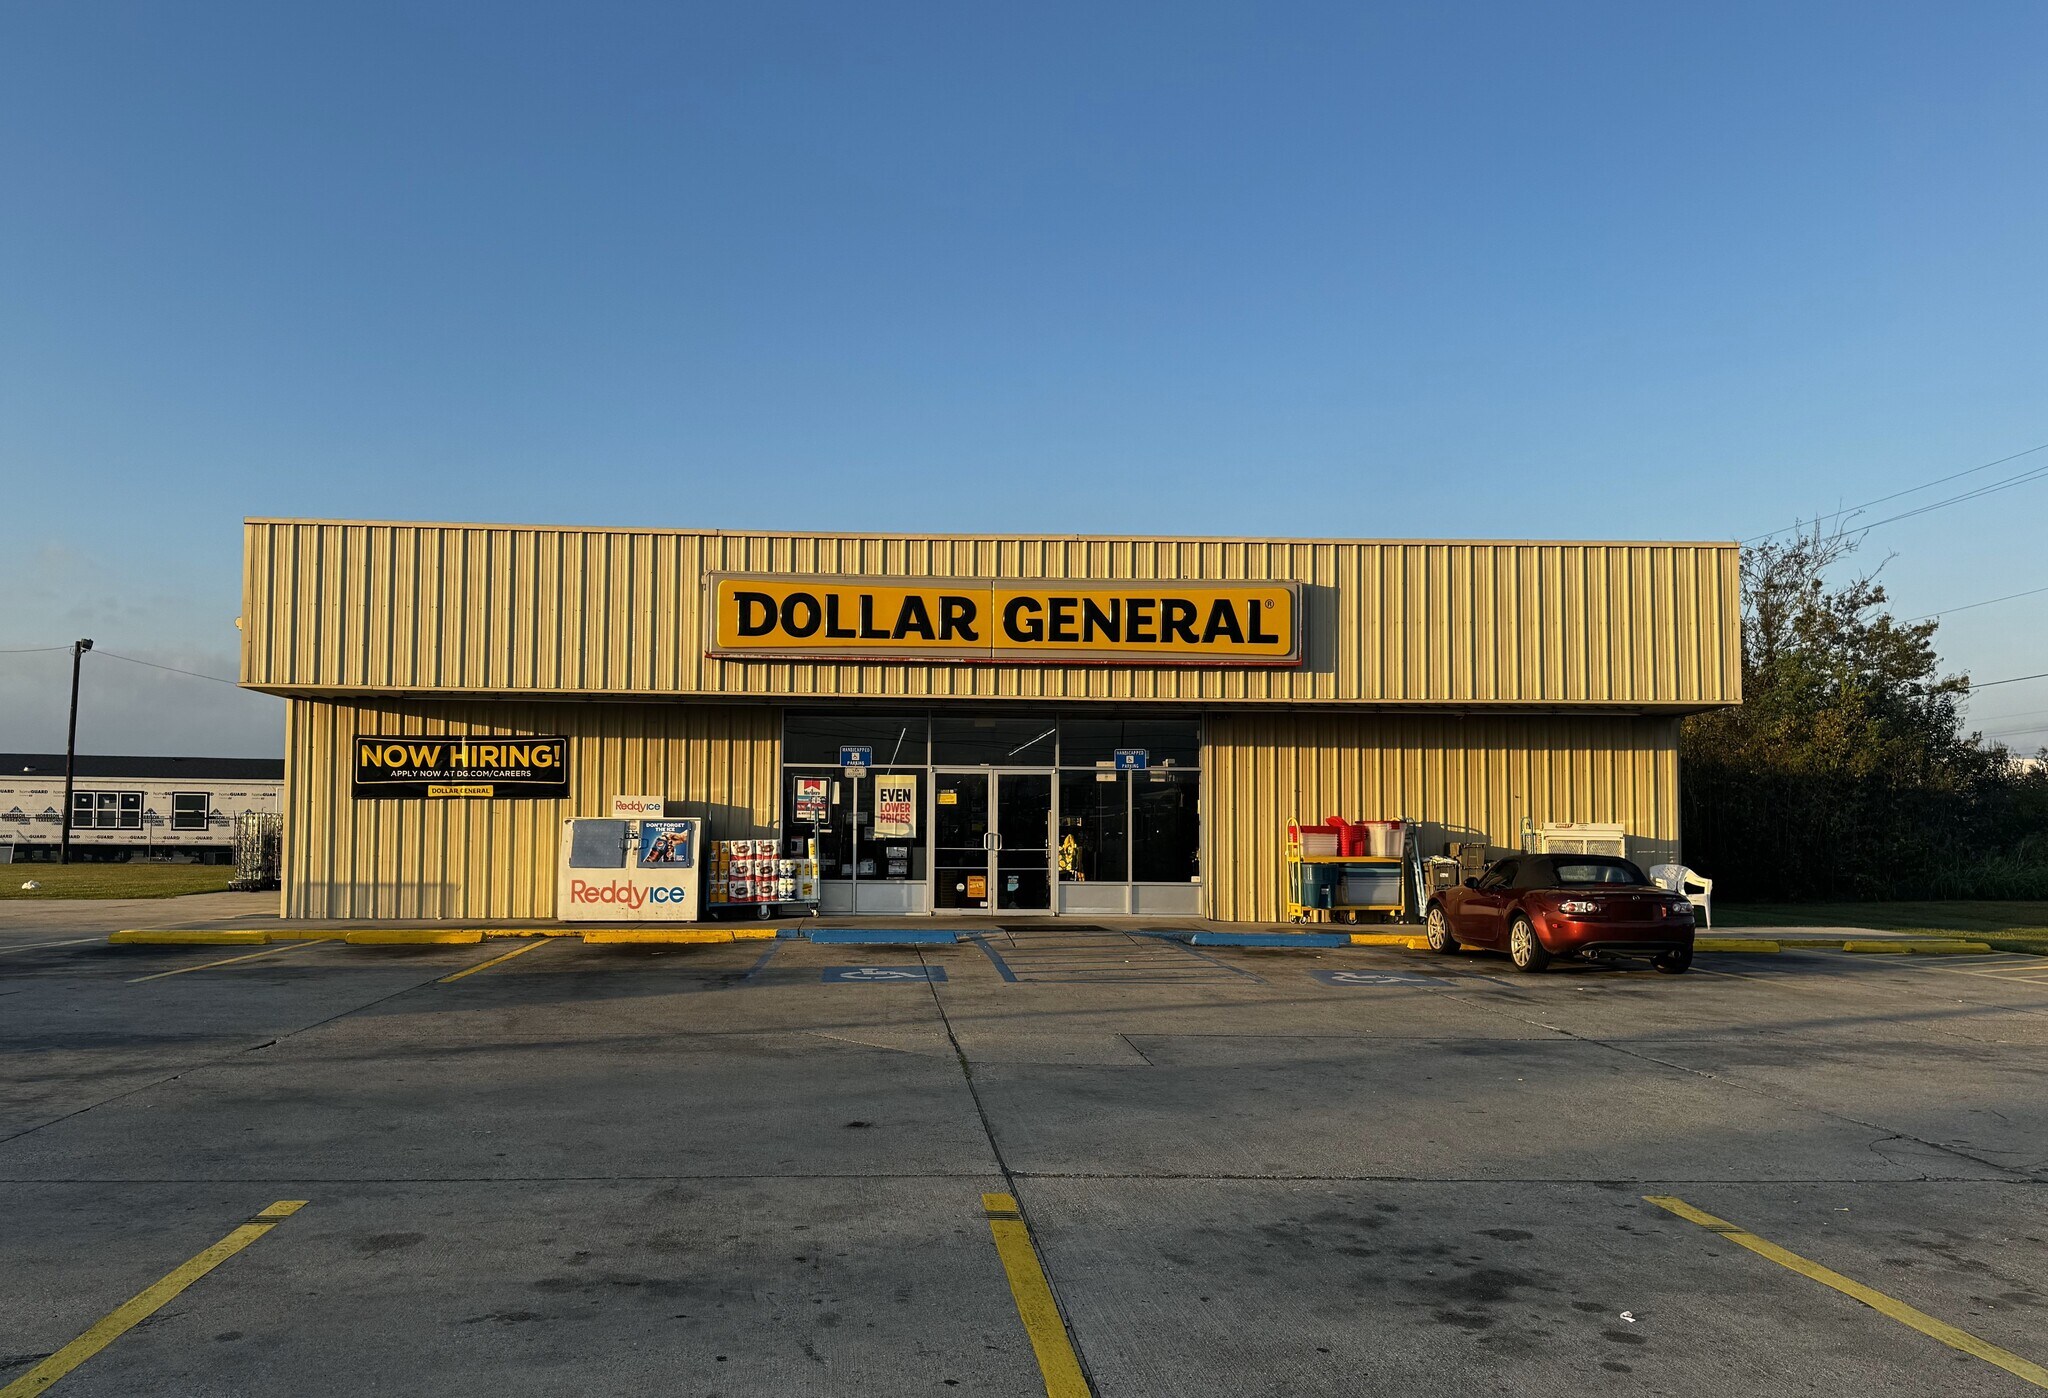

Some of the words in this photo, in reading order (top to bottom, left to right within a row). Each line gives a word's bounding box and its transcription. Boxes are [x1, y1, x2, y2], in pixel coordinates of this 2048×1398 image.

[733, 592, 979, 642] DOLLAR
[1003, 596, 1279, 644] GENERAL
[361, 745, 441, 768] NOW
[450, 745, 561, 768] HIRING!
[457, 770, 532, 778] DG.COM/CAREERS
[431, 787, 459, 795] DOLLAR
[880, 789, 911, 802] EVEN
[880, 803, 911, 812] LOWER
[880, 813, 911, 824] PRICES
